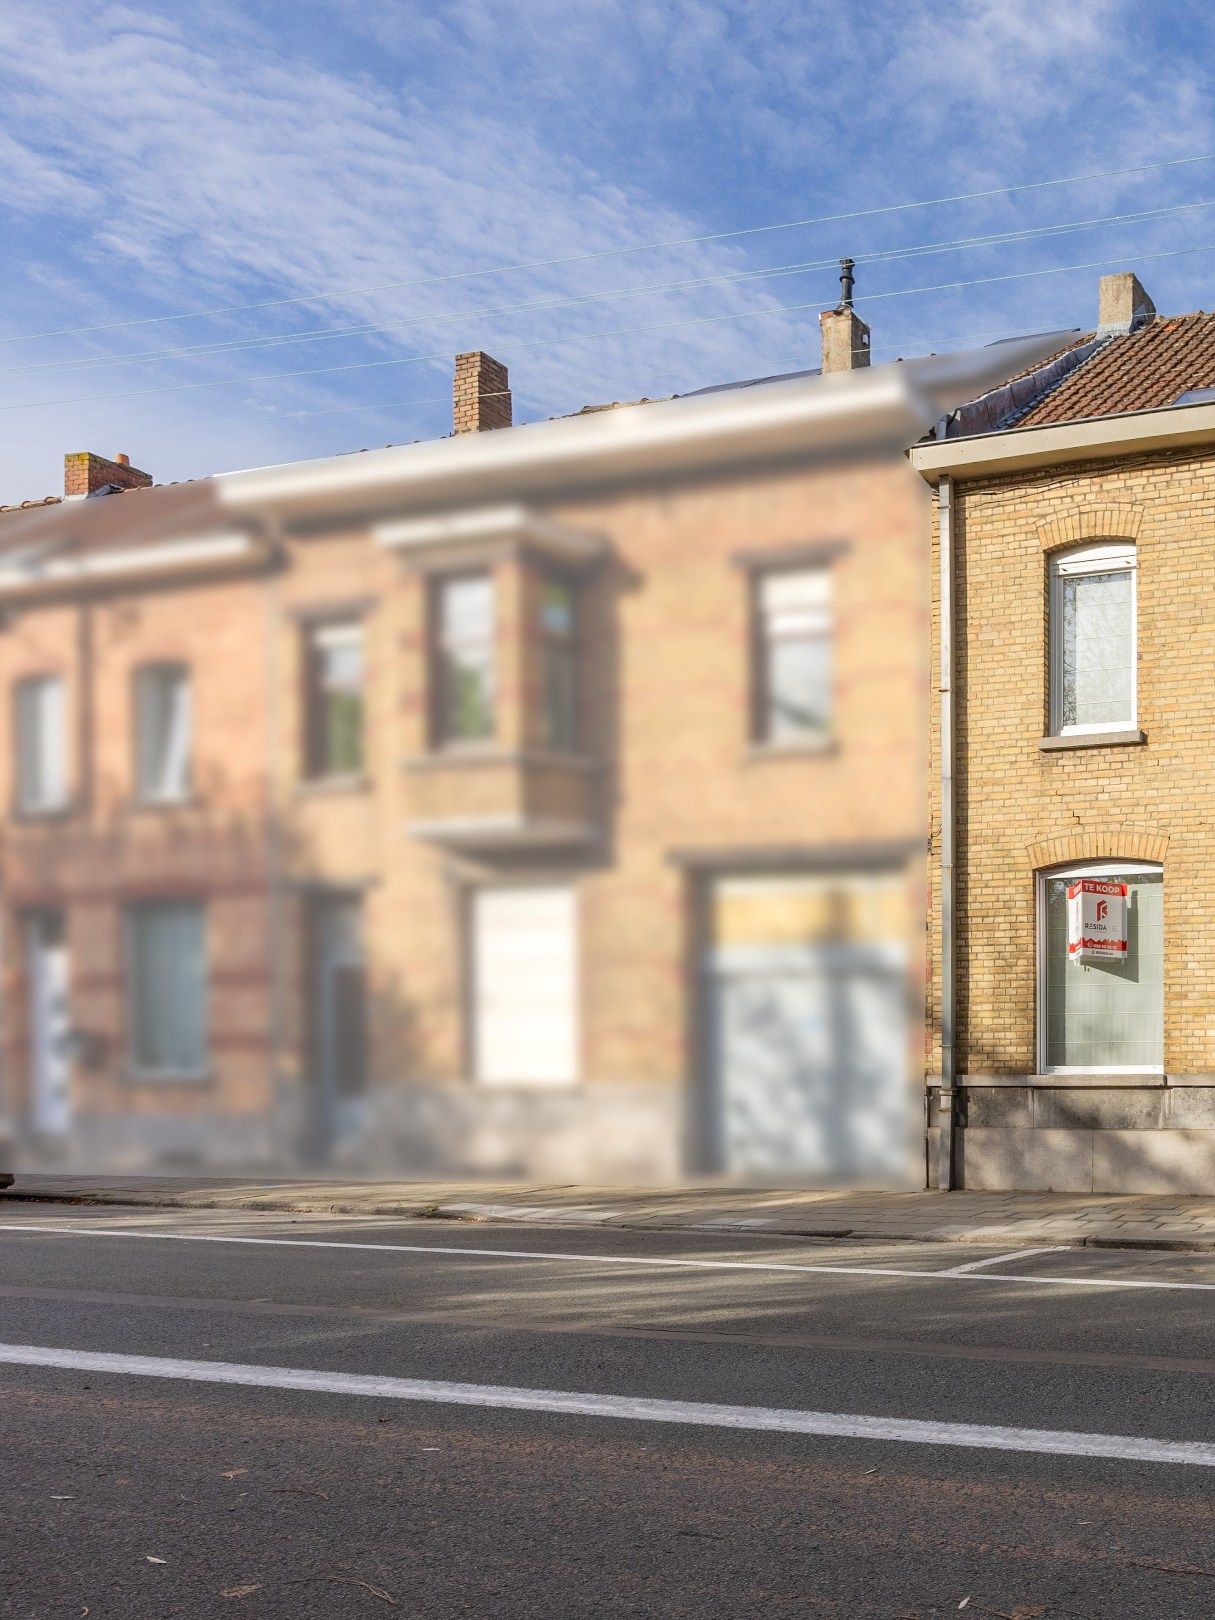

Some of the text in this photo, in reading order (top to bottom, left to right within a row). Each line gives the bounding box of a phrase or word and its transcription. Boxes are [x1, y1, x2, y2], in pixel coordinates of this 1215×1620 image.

[1084, 883, 1095, 891] TE
[1096, 884, 1120, 894] KOOP
[1084, 922, 1107, 931] RESIDA
